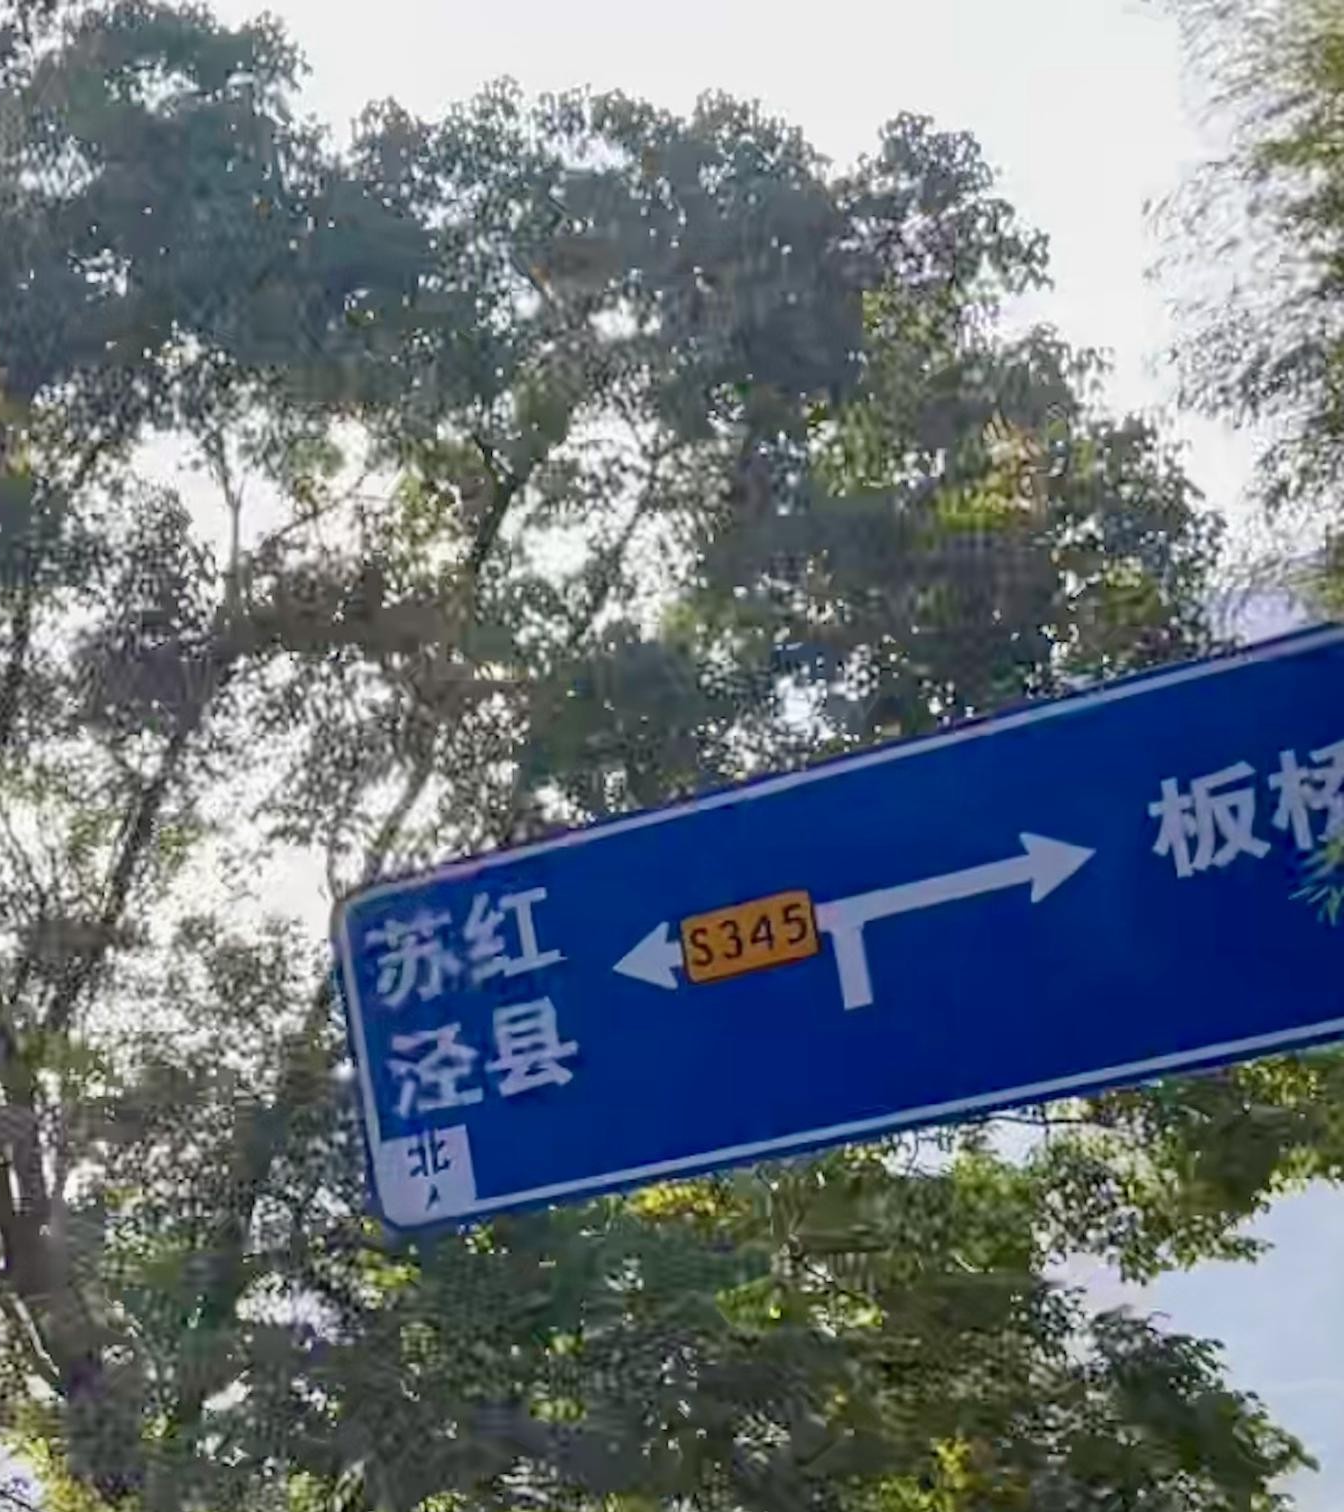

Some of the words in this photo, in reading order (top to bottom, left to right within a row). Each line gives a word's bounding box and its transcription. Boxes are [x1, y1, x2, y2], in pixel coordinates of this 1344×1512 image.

[364, 886, 565, 1009] 苏红
[689, 902, 808, 967] S345
[385, 996, 579, 1117] 泾县
[408, 1138, 450, 1178] 北
